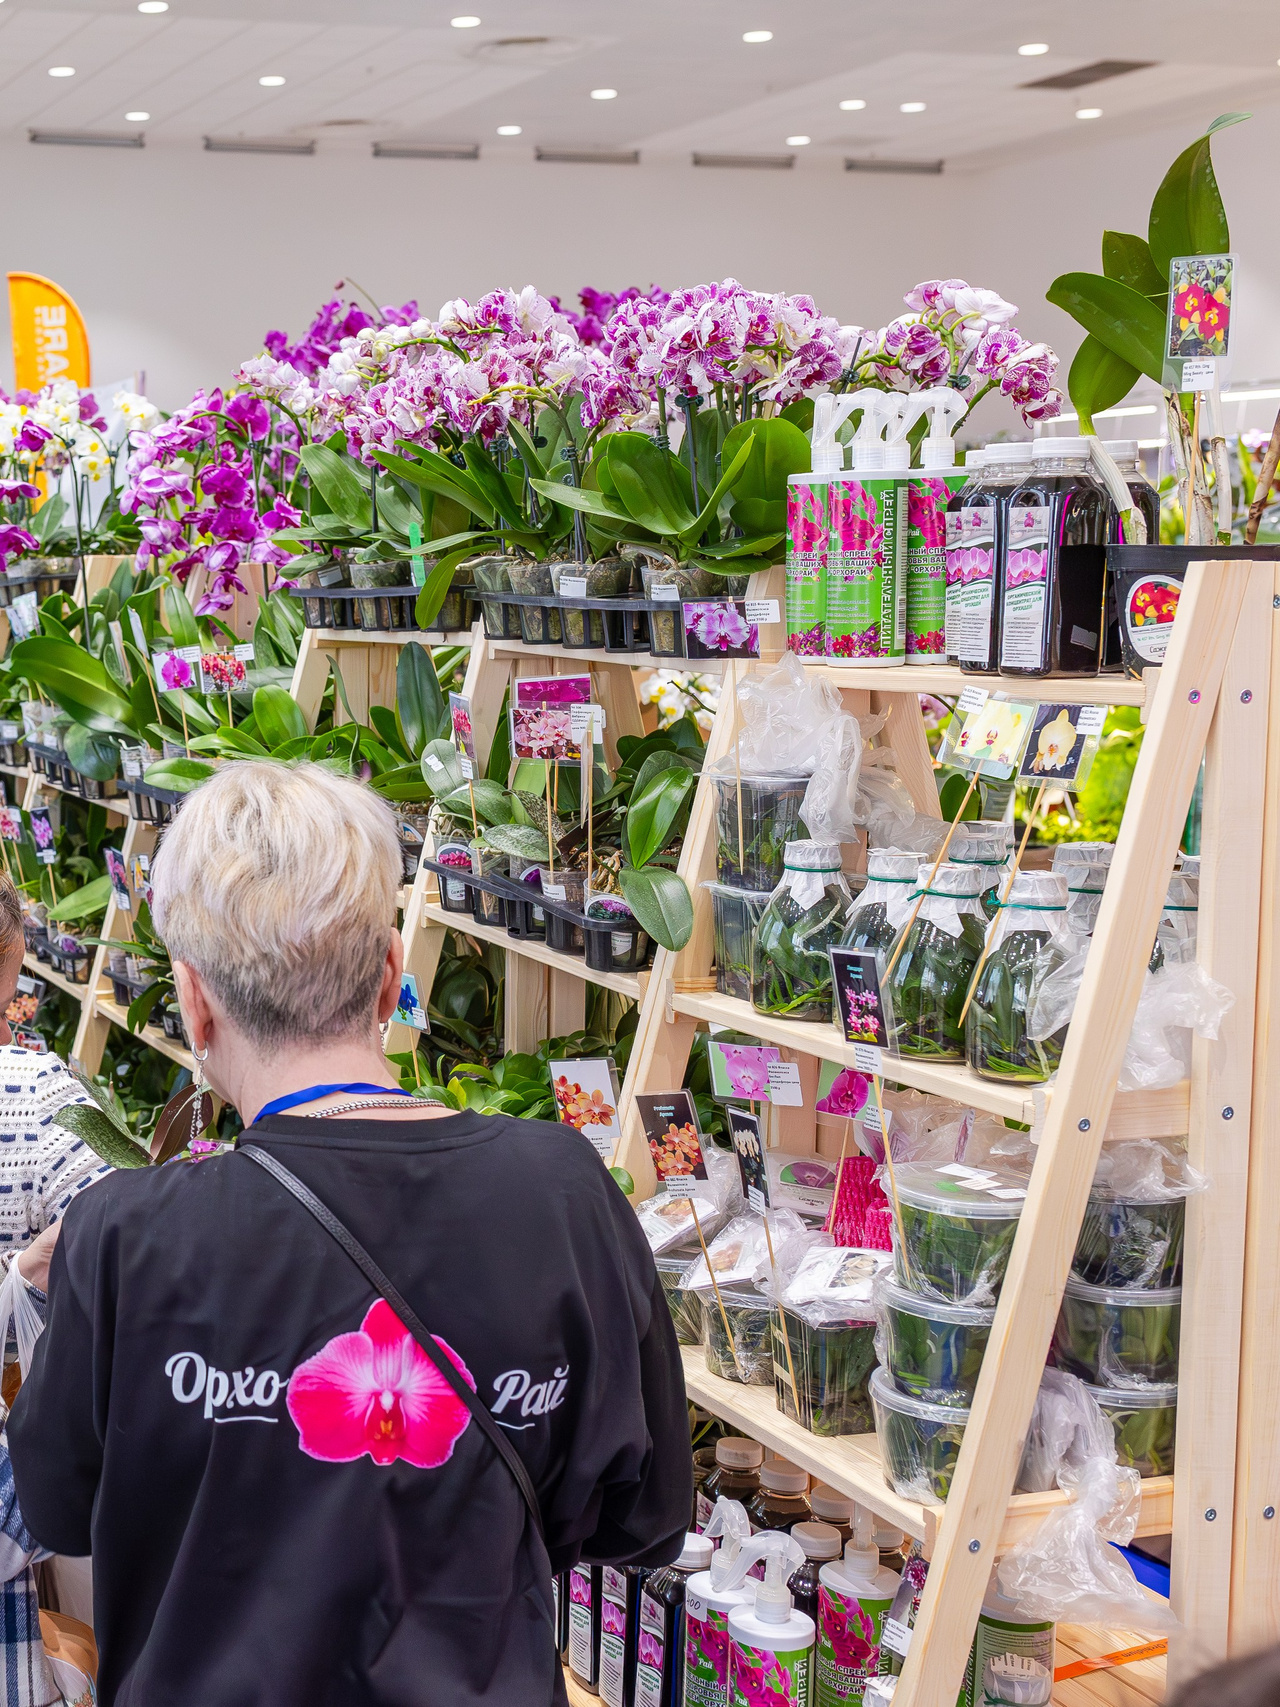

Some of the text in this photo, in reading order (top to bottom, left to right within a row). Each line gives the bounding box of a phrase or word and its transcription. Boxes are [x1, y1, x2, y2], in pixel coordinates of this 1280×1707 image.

[844, 550, 872, 558] СПРЕЙ
[845, 559, 876, 567] ВАШИХ
[879, 490, 894, 648] ПИТАТЕЛЬНЫЙ СПРЕЙ
[165, 1351, 570, 1419] Орхо Рай
[837, 1664, 867, 1676] СПРЕЙ
